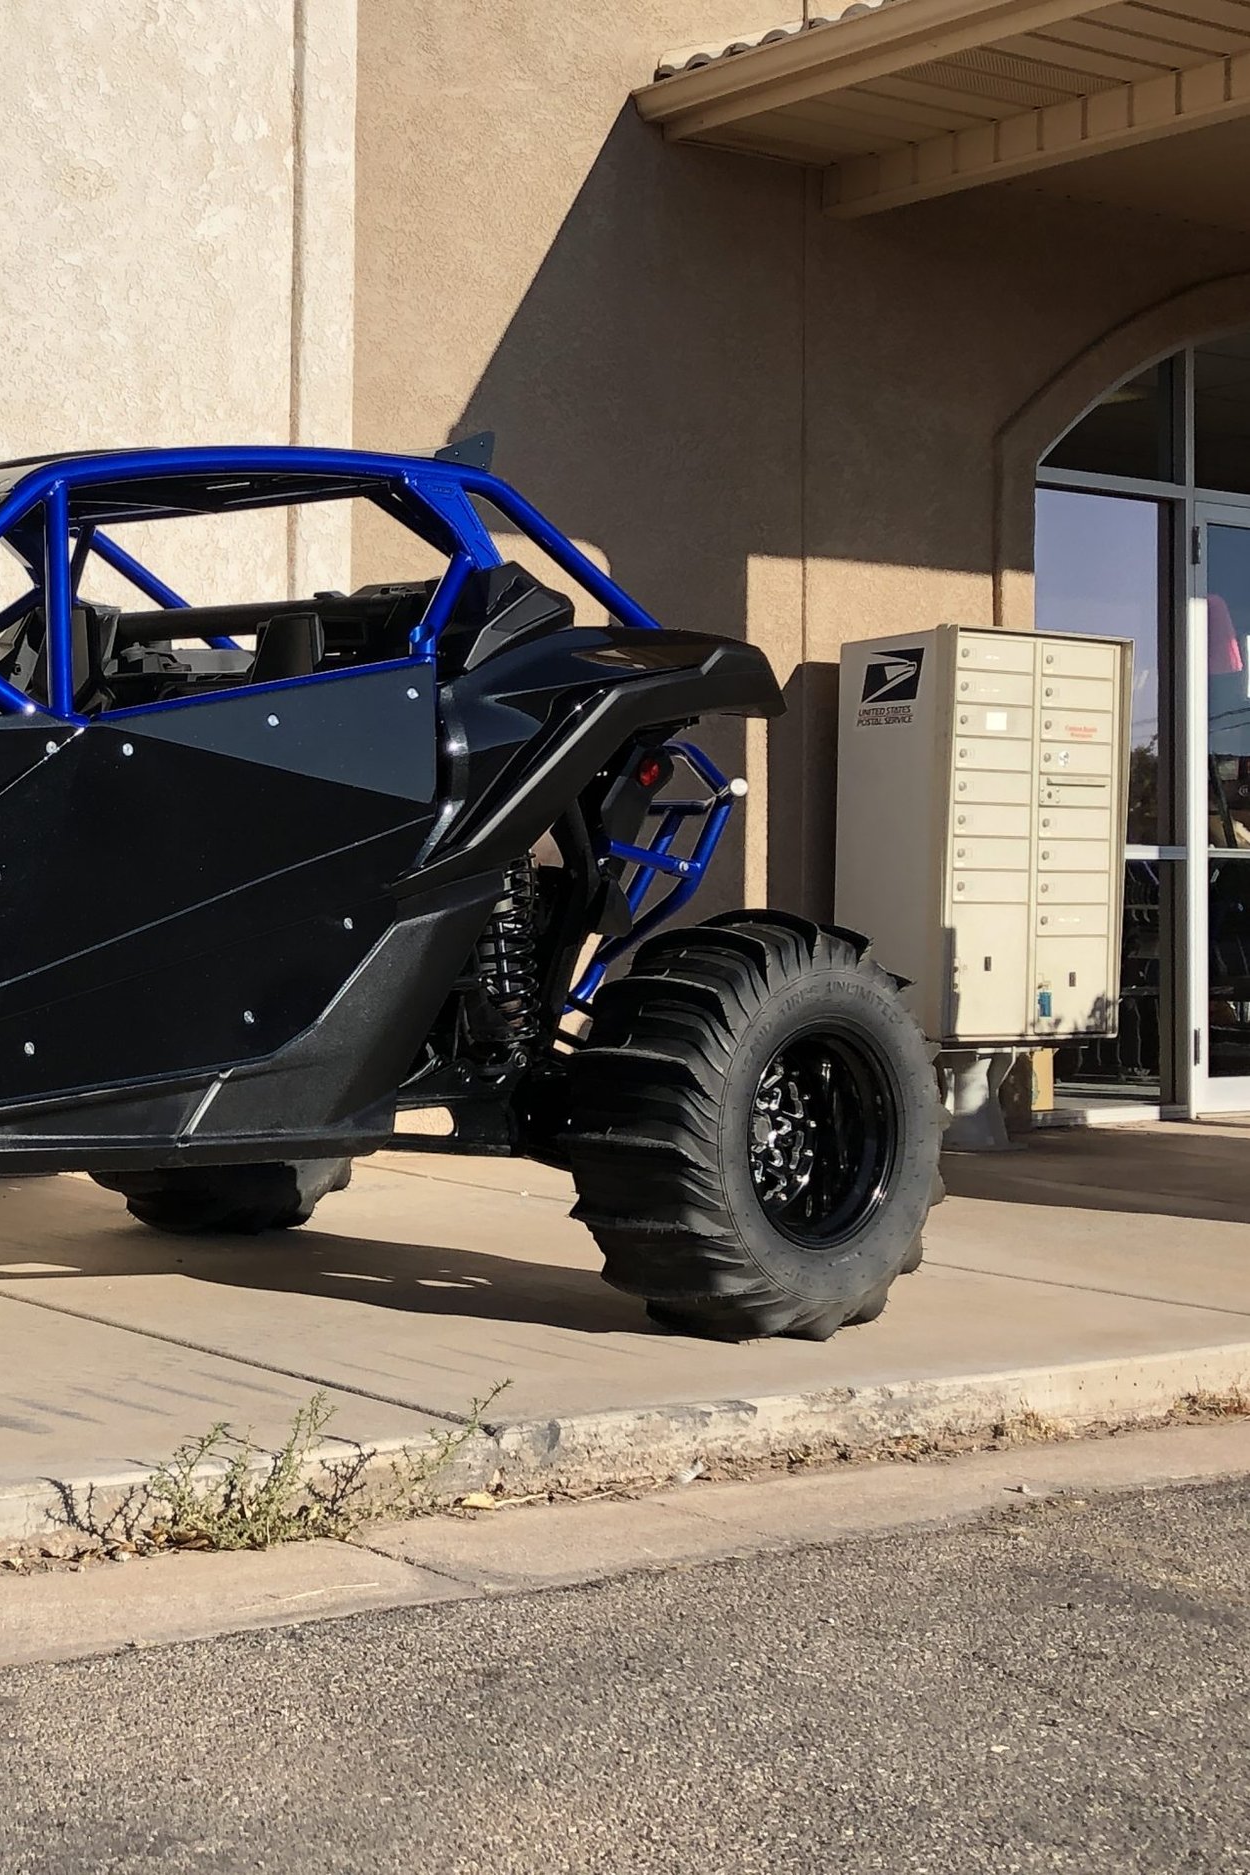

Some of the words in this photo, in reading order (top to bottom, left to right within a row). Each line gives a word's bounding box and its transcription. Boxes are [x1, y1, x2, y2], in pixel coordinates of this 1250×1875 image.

[858, 707, 886, 717] UNITED
[886, 705, 911, 714] STATES
[856, 717, 883, 727] POSTAL
[884, 714, 914, 725] SERVICE
